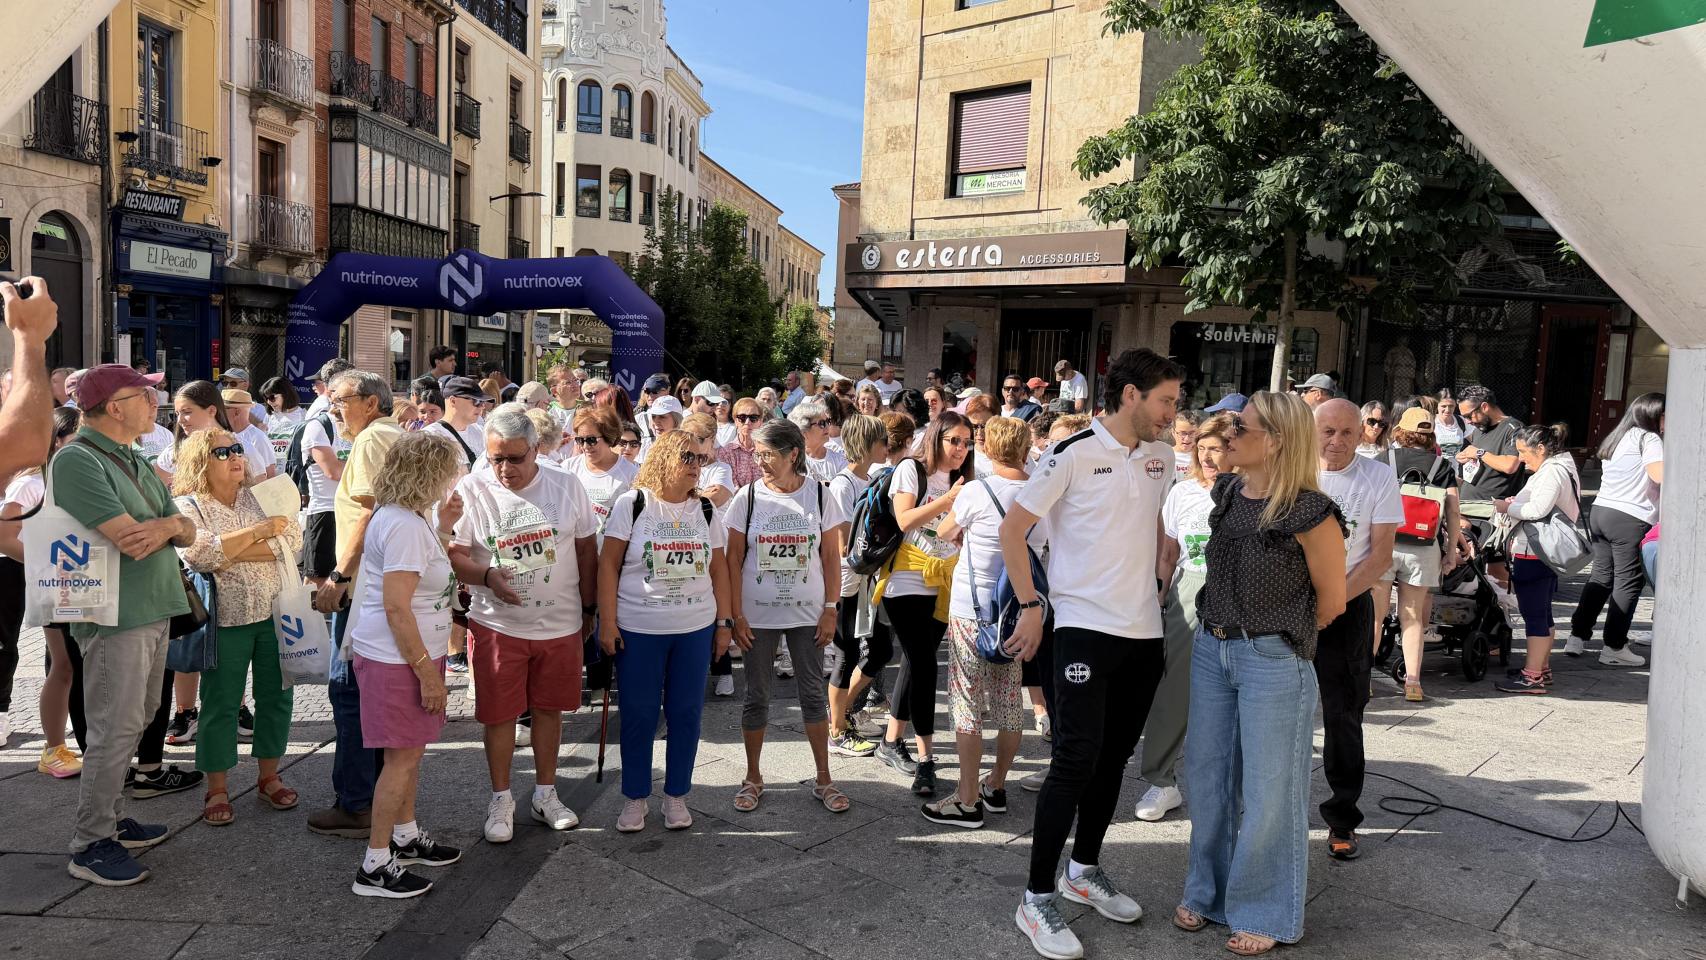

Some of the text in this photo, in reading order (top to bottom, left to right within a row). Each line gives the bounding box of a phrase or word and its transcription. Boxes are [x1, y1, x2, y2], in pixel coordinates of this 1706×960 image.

[986, 179, 1023, 189] MERCHAN
[124, 191, 181, 215] RESTAURANTE
[147, 246, 198, 270] El Pecado
[895, 241, 1101, 268] esterra ACCESSORIES
[341, 270, 419, 288] nutrinovex
[503, 273, 583, 289] nutrinovex
[1204, 330, 1276, 345] SOUVENIR
[1093, 467, 1113, 475] JAKO
[496, 529, 553, 550] bedunia
[653, 541, 703, 551] bedunia
[758, 534, 808, 544] bedunia
[512, 541, 544, 561] 310
[665, 551, 694, 565] 473
[768, 544, 797, 558] 423
[38, 577, 103, 588] nutrinovex
